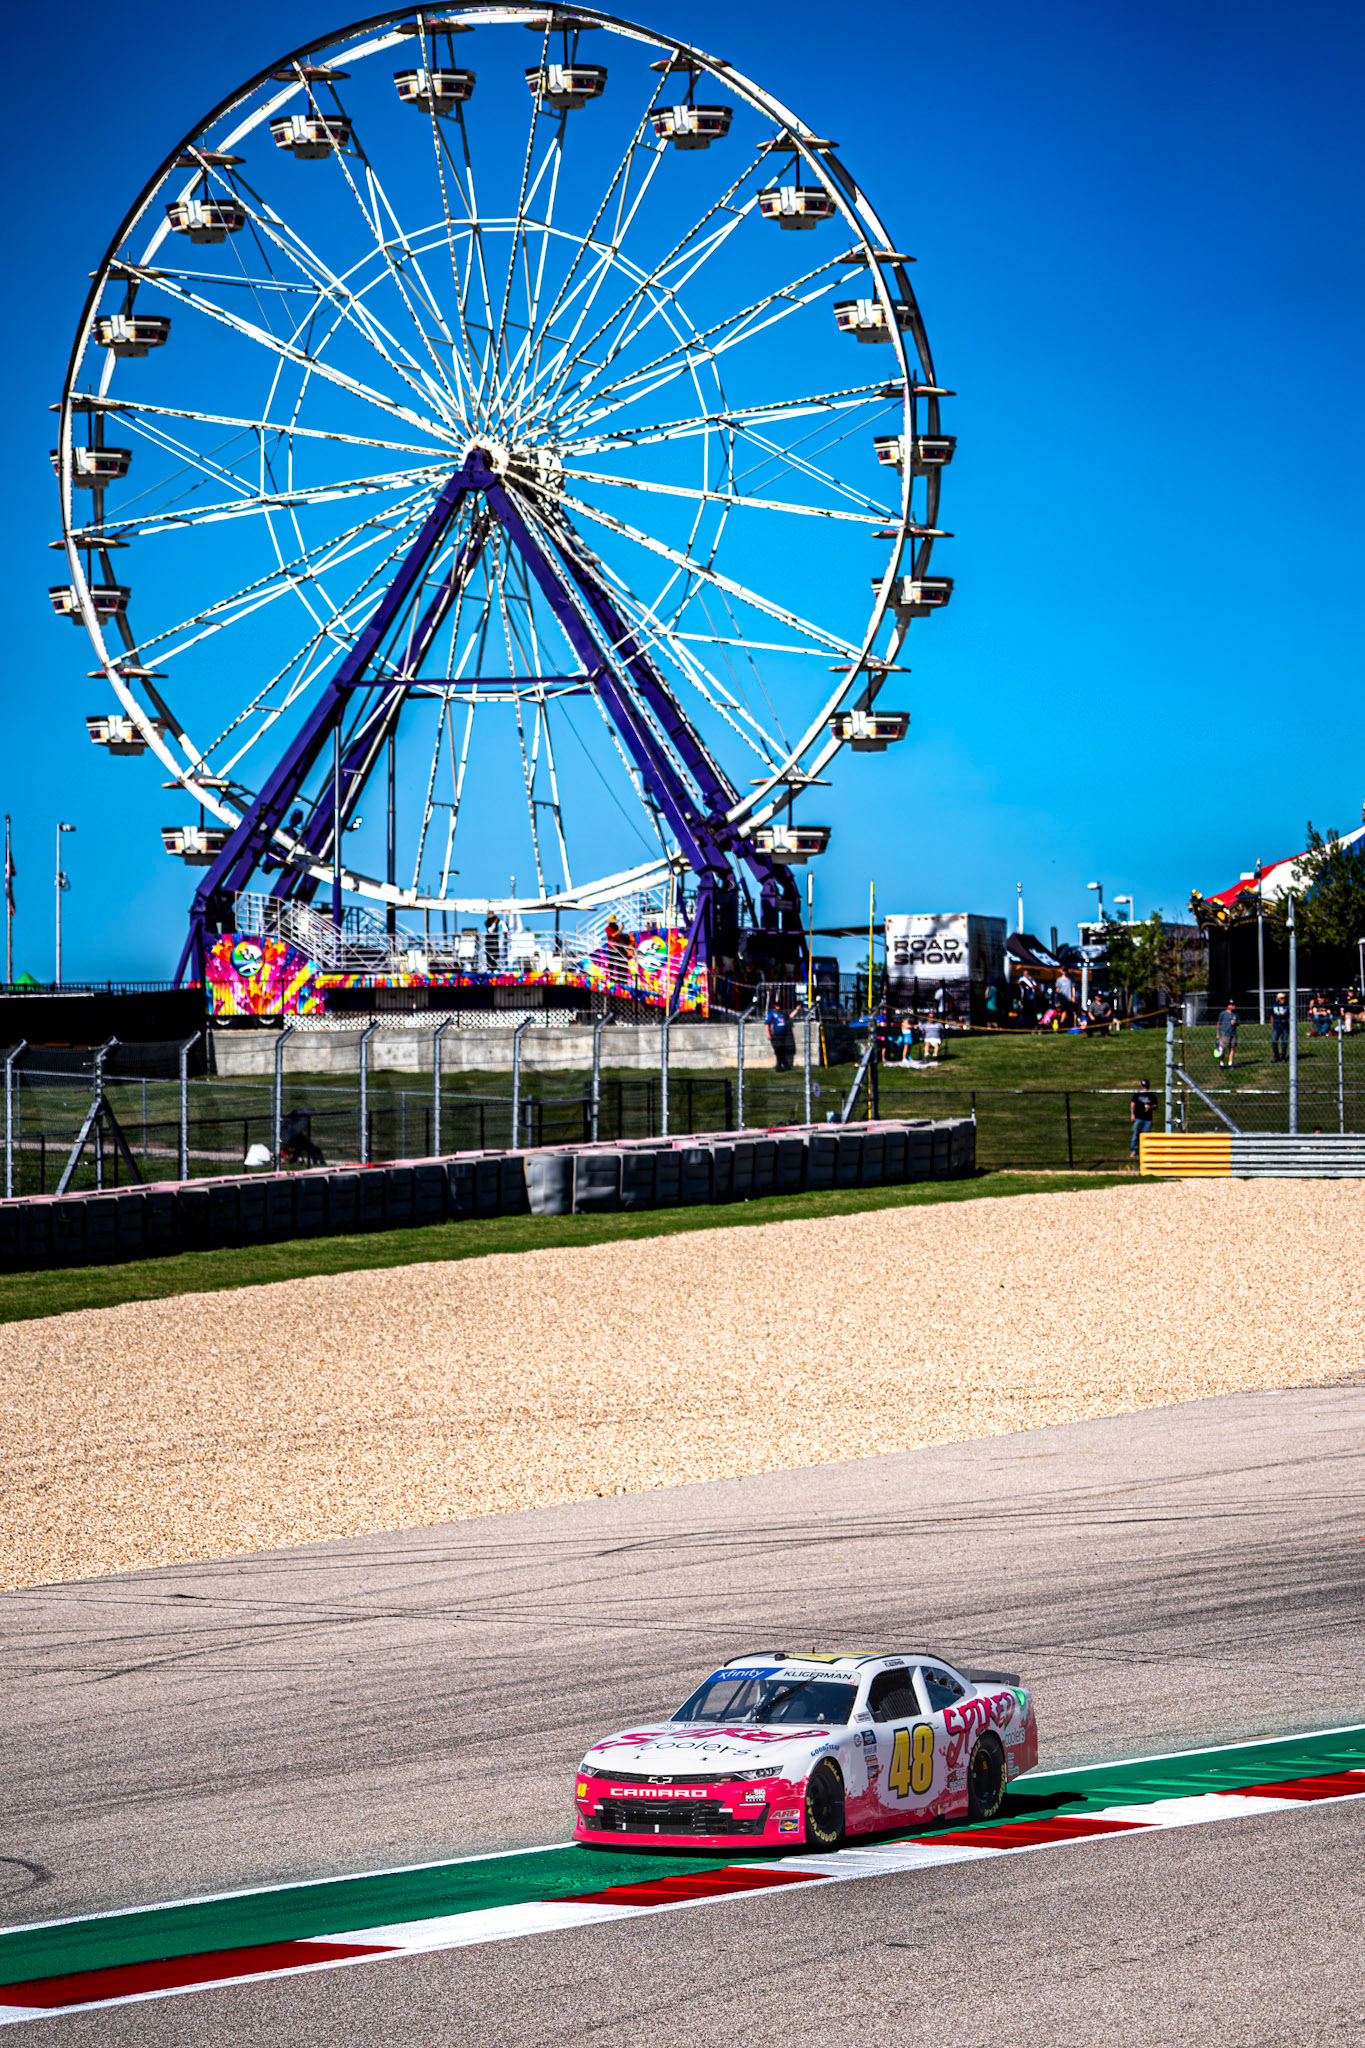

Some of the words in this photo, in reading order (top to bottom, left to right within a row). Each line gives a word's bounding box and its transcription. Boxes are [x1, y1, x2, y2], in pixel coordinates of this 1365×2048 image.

[894, 939, 959, 952] ROAD
[894, 952, 962, 965] SHOW
[718, 1669, 765, 1680] xfinity
[783, 1671, 852, 1680] KLIGERMAN
[943, 1692, 1016, 1768] SPIKED
[591, 1727, 831, 1750] SPIKED
[1005, 1728, 1026, 1747] coolers
[639, 1740, 751, 1756] coolers
[810, 1743, 840, 1757] GOODYEAR
[888, 1723, 935, 1800] 48
[577, 1783, 587, 1797] 48
[610, 1788, 707, 1797] CAMARO
[772, 1809, 799, 1818] ARP
